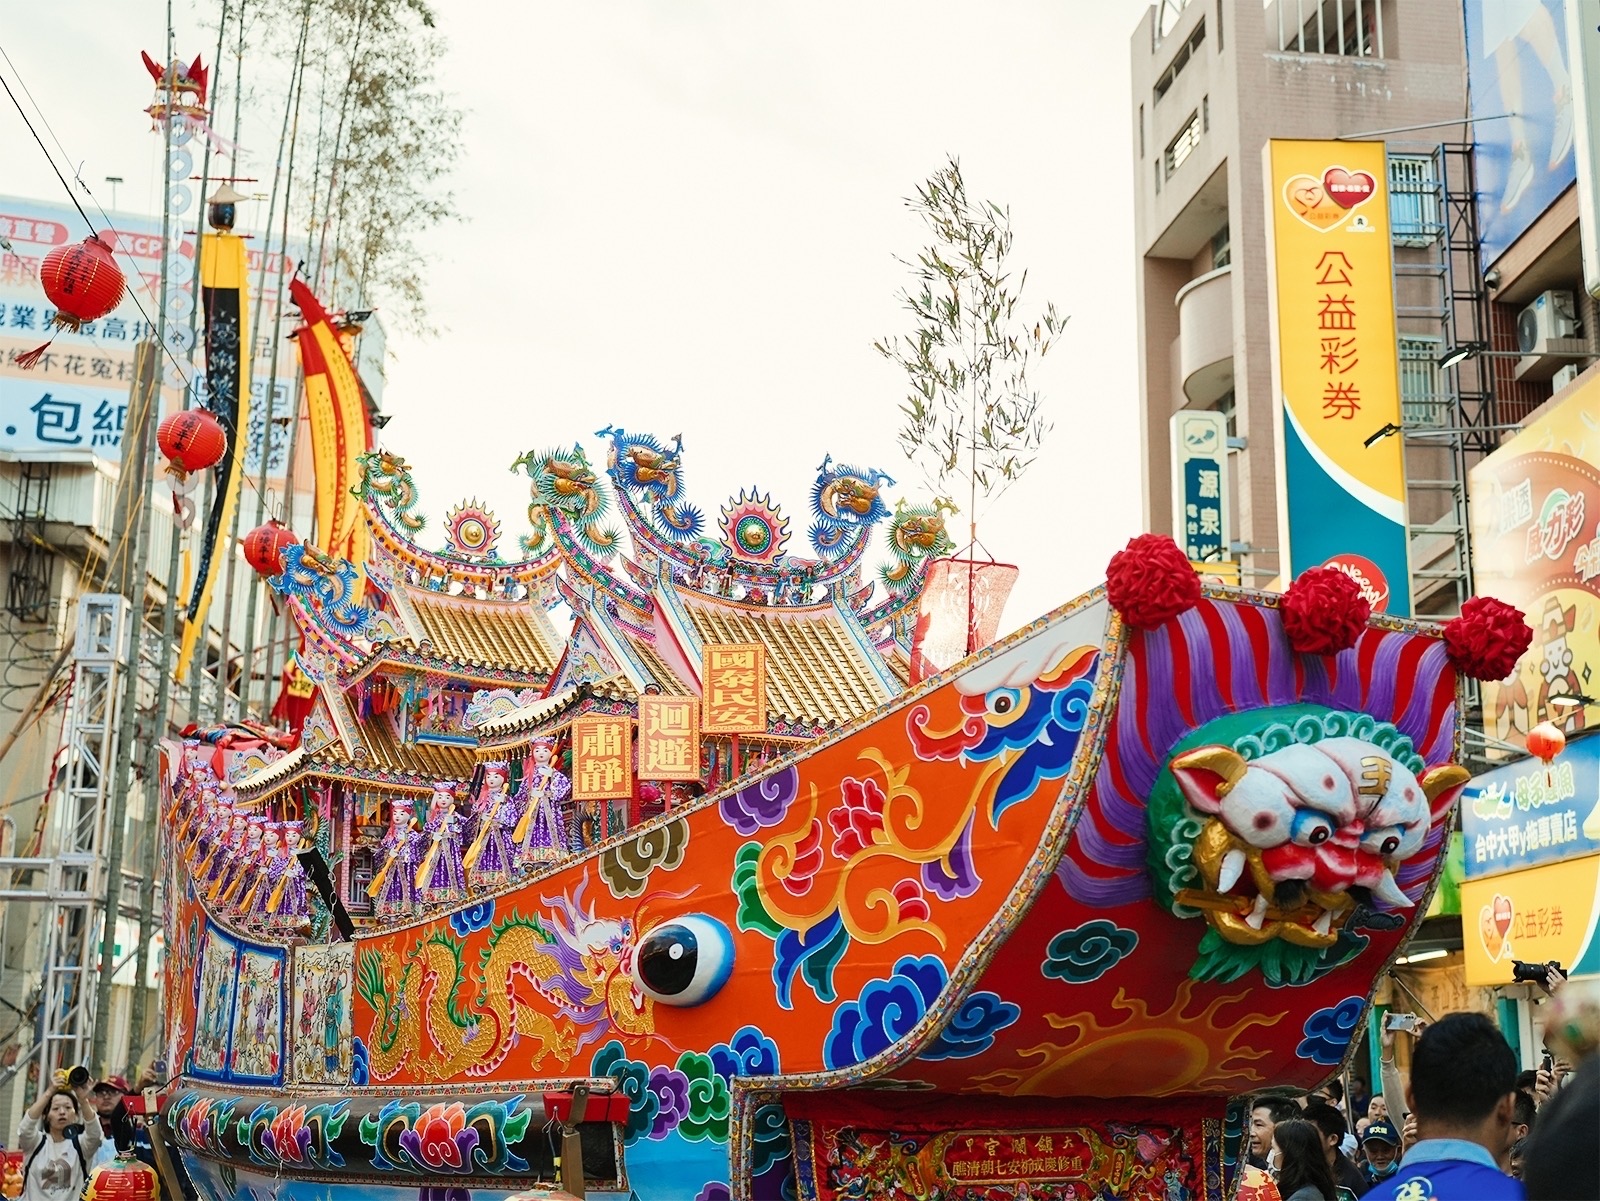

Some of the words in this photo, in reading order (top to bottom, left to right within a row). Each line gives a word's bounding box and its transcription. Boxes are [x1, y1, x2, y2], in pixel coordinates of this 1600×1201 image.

[1315, 251, 1361, 420] 公益彩券
[710, 651, 757, 725] 國泰民安
[580, 724, 624, 792] 肅靜
[647, 703, 692, 772] 迴避
[1514, 905, 1563, 940] 公益彩券
